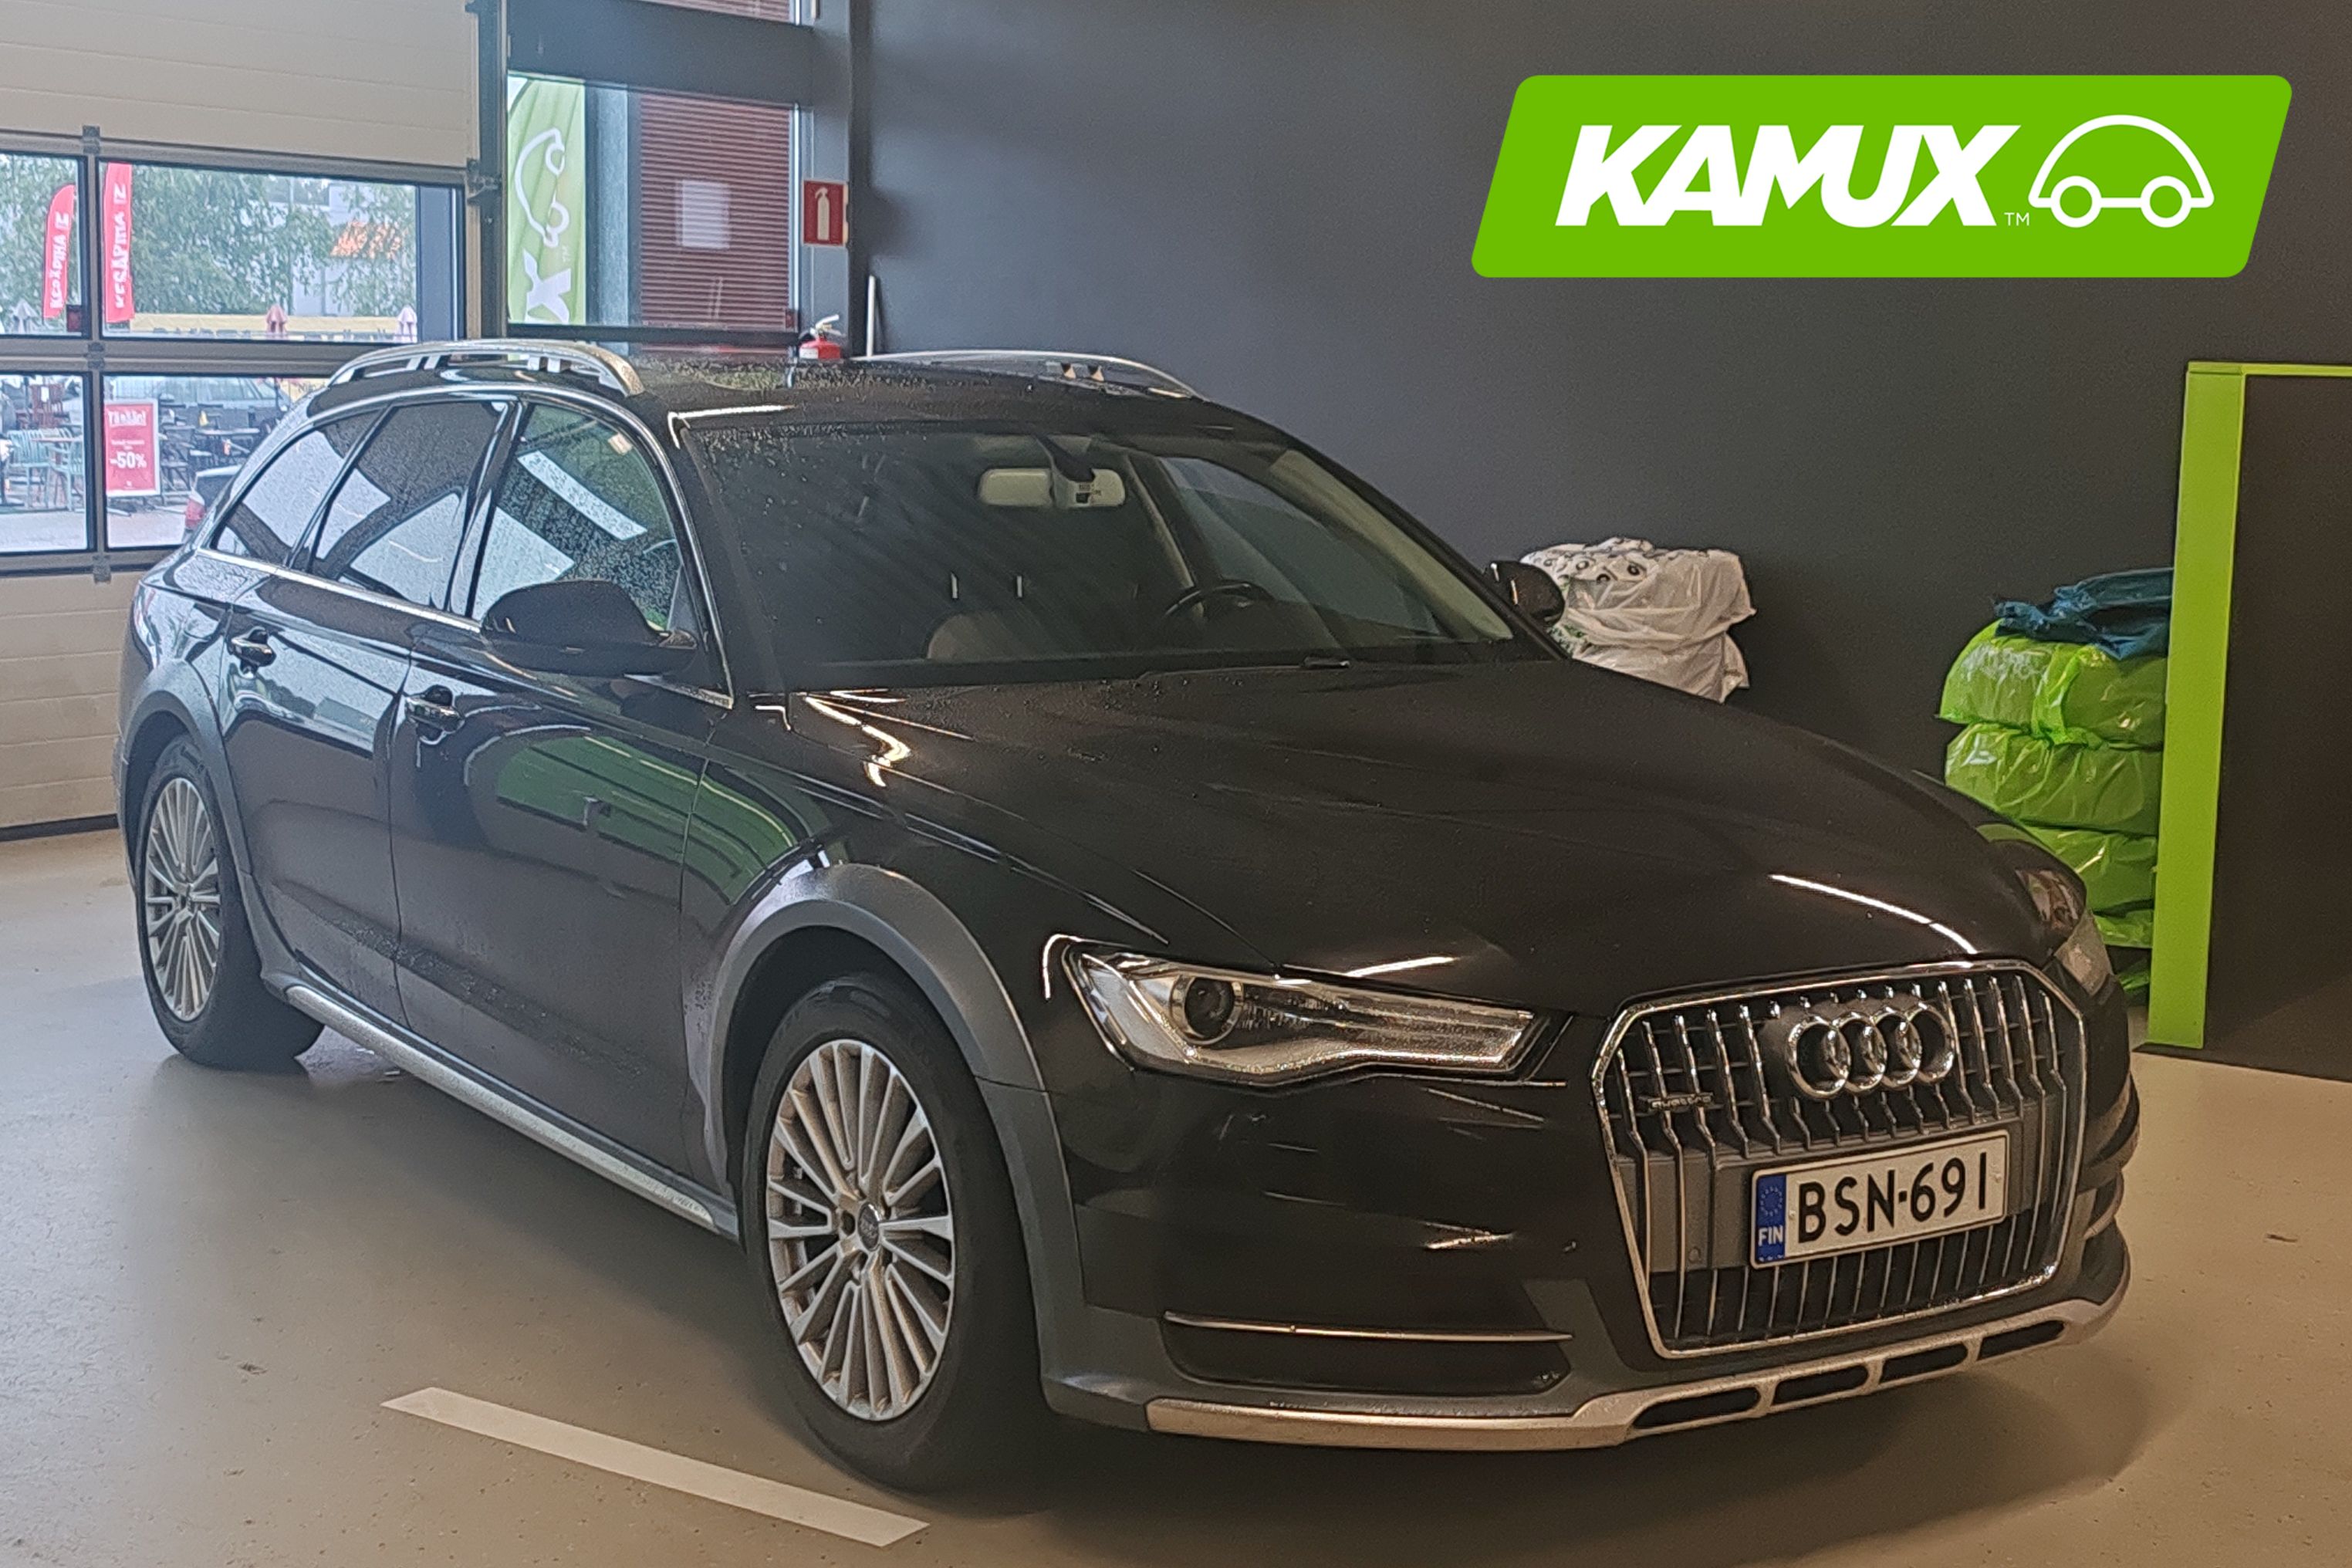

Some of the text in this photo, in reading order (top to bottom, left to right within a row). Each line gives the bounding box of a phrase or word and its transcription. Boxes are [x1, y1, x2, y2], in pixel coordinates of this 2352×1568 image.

[110, 451, 147, 469] -50%
[1798, 1151, 1987, 1244] BSN-691
[1758, 1225, 1784, 1247] FIN
